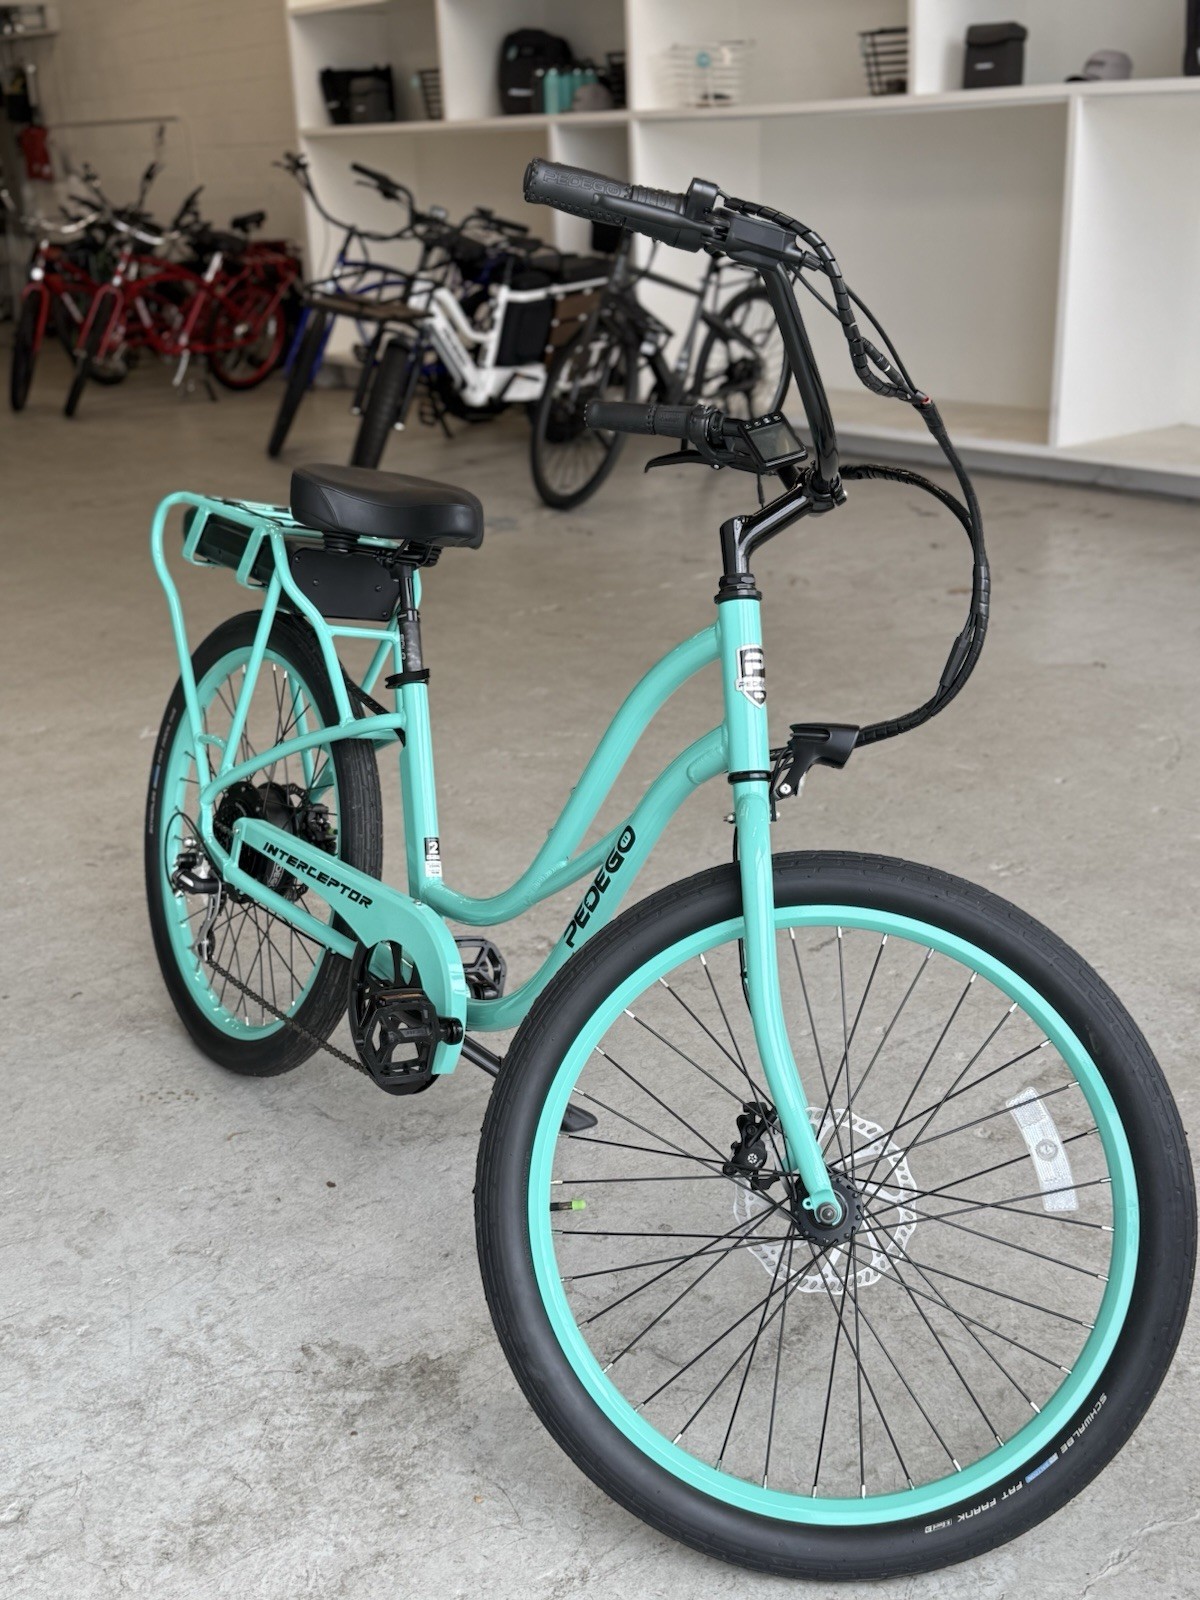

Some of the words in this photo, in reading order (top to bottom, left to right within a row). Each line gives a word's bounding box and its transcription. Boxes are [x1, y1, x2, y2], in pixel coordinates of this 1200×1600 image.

[542, 169, 623, 198] PEDEGO
[428, 841, 439, 854] 2
[263, 842, 373, 909] INTERCEPTOR
[564, 825, 636, 948] PEDEGO
[1059, 1393, 1108, 1454] SCHWALBE
[1001, 1480, 1024, 1500] FAT
[957, 1497, 997, 1522] FRANK
